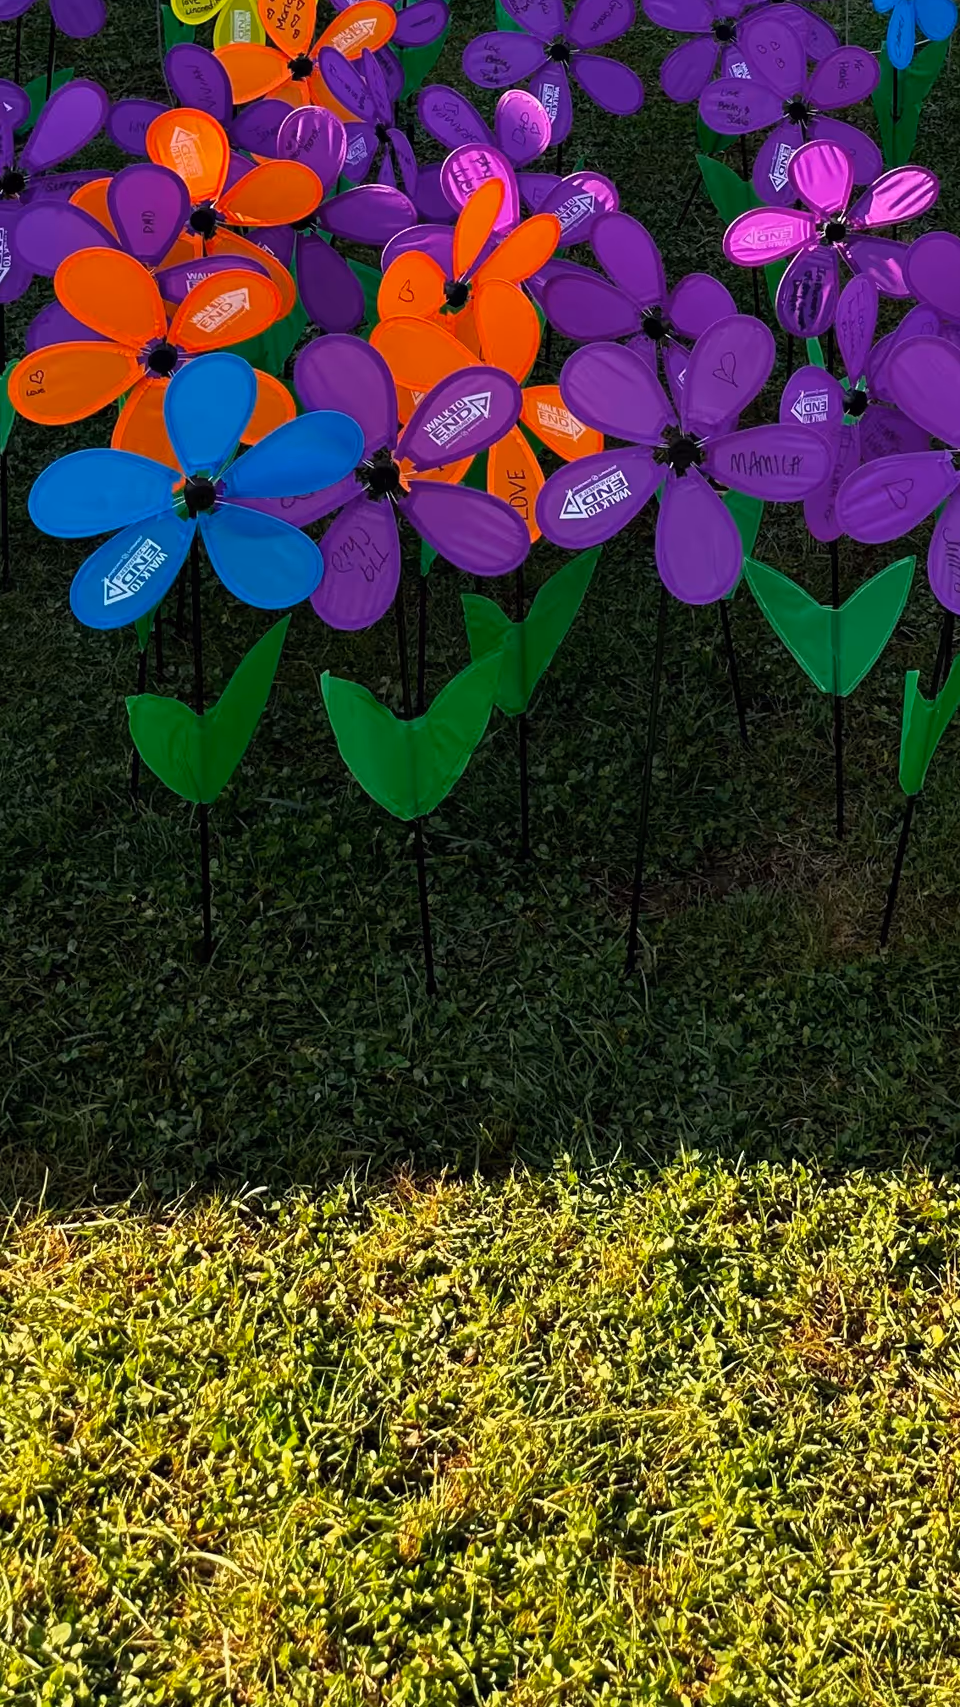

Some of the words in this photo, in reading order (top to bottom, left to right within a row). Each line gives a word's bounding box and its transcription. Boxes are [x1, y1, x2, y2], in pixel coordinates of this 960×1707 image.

[590, 0, 623, 32] Grandpa
[190, 302, 212, 324] WALK
[200, 302, 233, 330] END
[423, 412, 452, 432] WALK
[450, 399, 464, 413] TO
[432, 406, 473, 440] END
[537, 401, 559, 415] WALK
[558, 407, 568, 418] TO
[538, 412, 569, 428] END
[507, 469, 528, 520] LOVE
[582, 478, 628, 505] END
[603, 490, 632, 510] WALK
[586, 502, 602, 516] TO
[119, 544, 161, 586] END
[147, 552, 168, 581] WALK
[131, 578, 148, 593] TO
